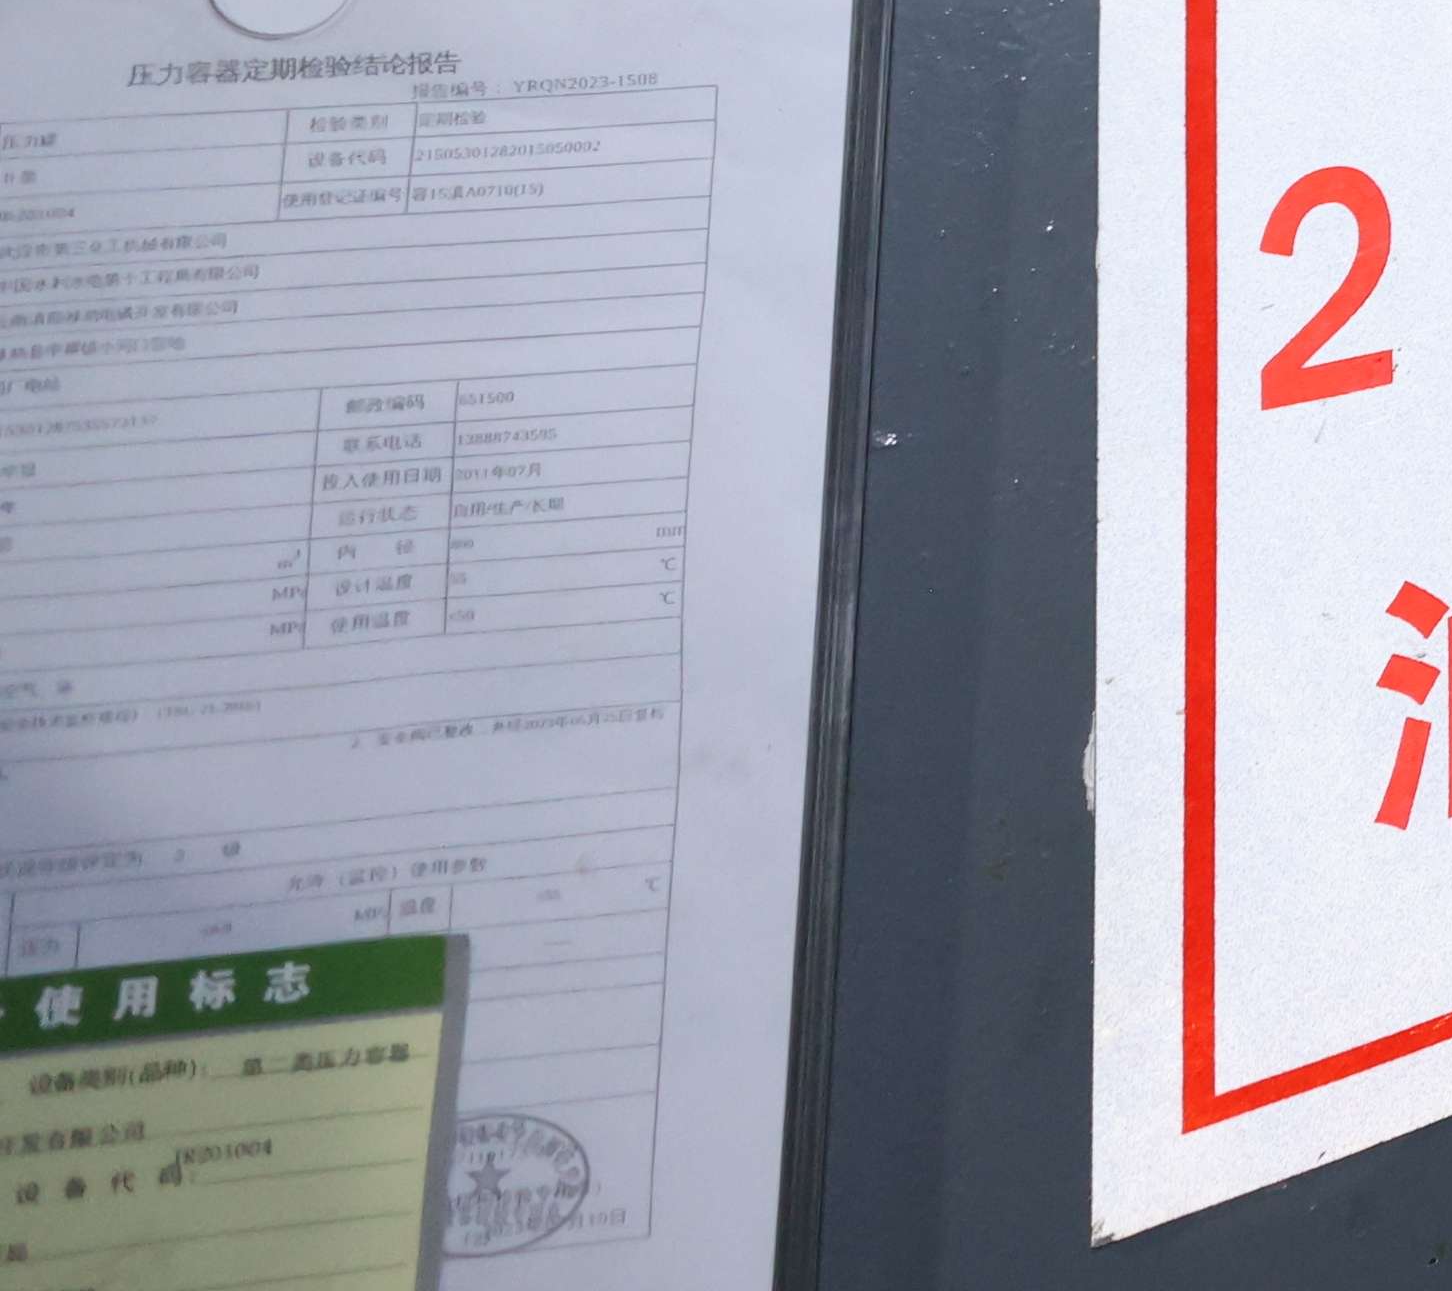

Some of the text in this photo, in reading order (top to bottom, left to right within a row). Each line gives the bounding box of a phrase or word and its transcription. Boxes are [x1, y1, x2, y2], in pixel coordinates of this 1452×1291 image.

[125, 50, 462, 90] 压力容器定期检验结论报告
[306, 148, 388, 170] 设备代码
[282, 184, 405, 209] 使用登记证编号
[342, 432, 423, 452] 联系电话
[321, 467, 442, 492] 投入使用日期
[0, 960, 312, 1031] 使用标志
